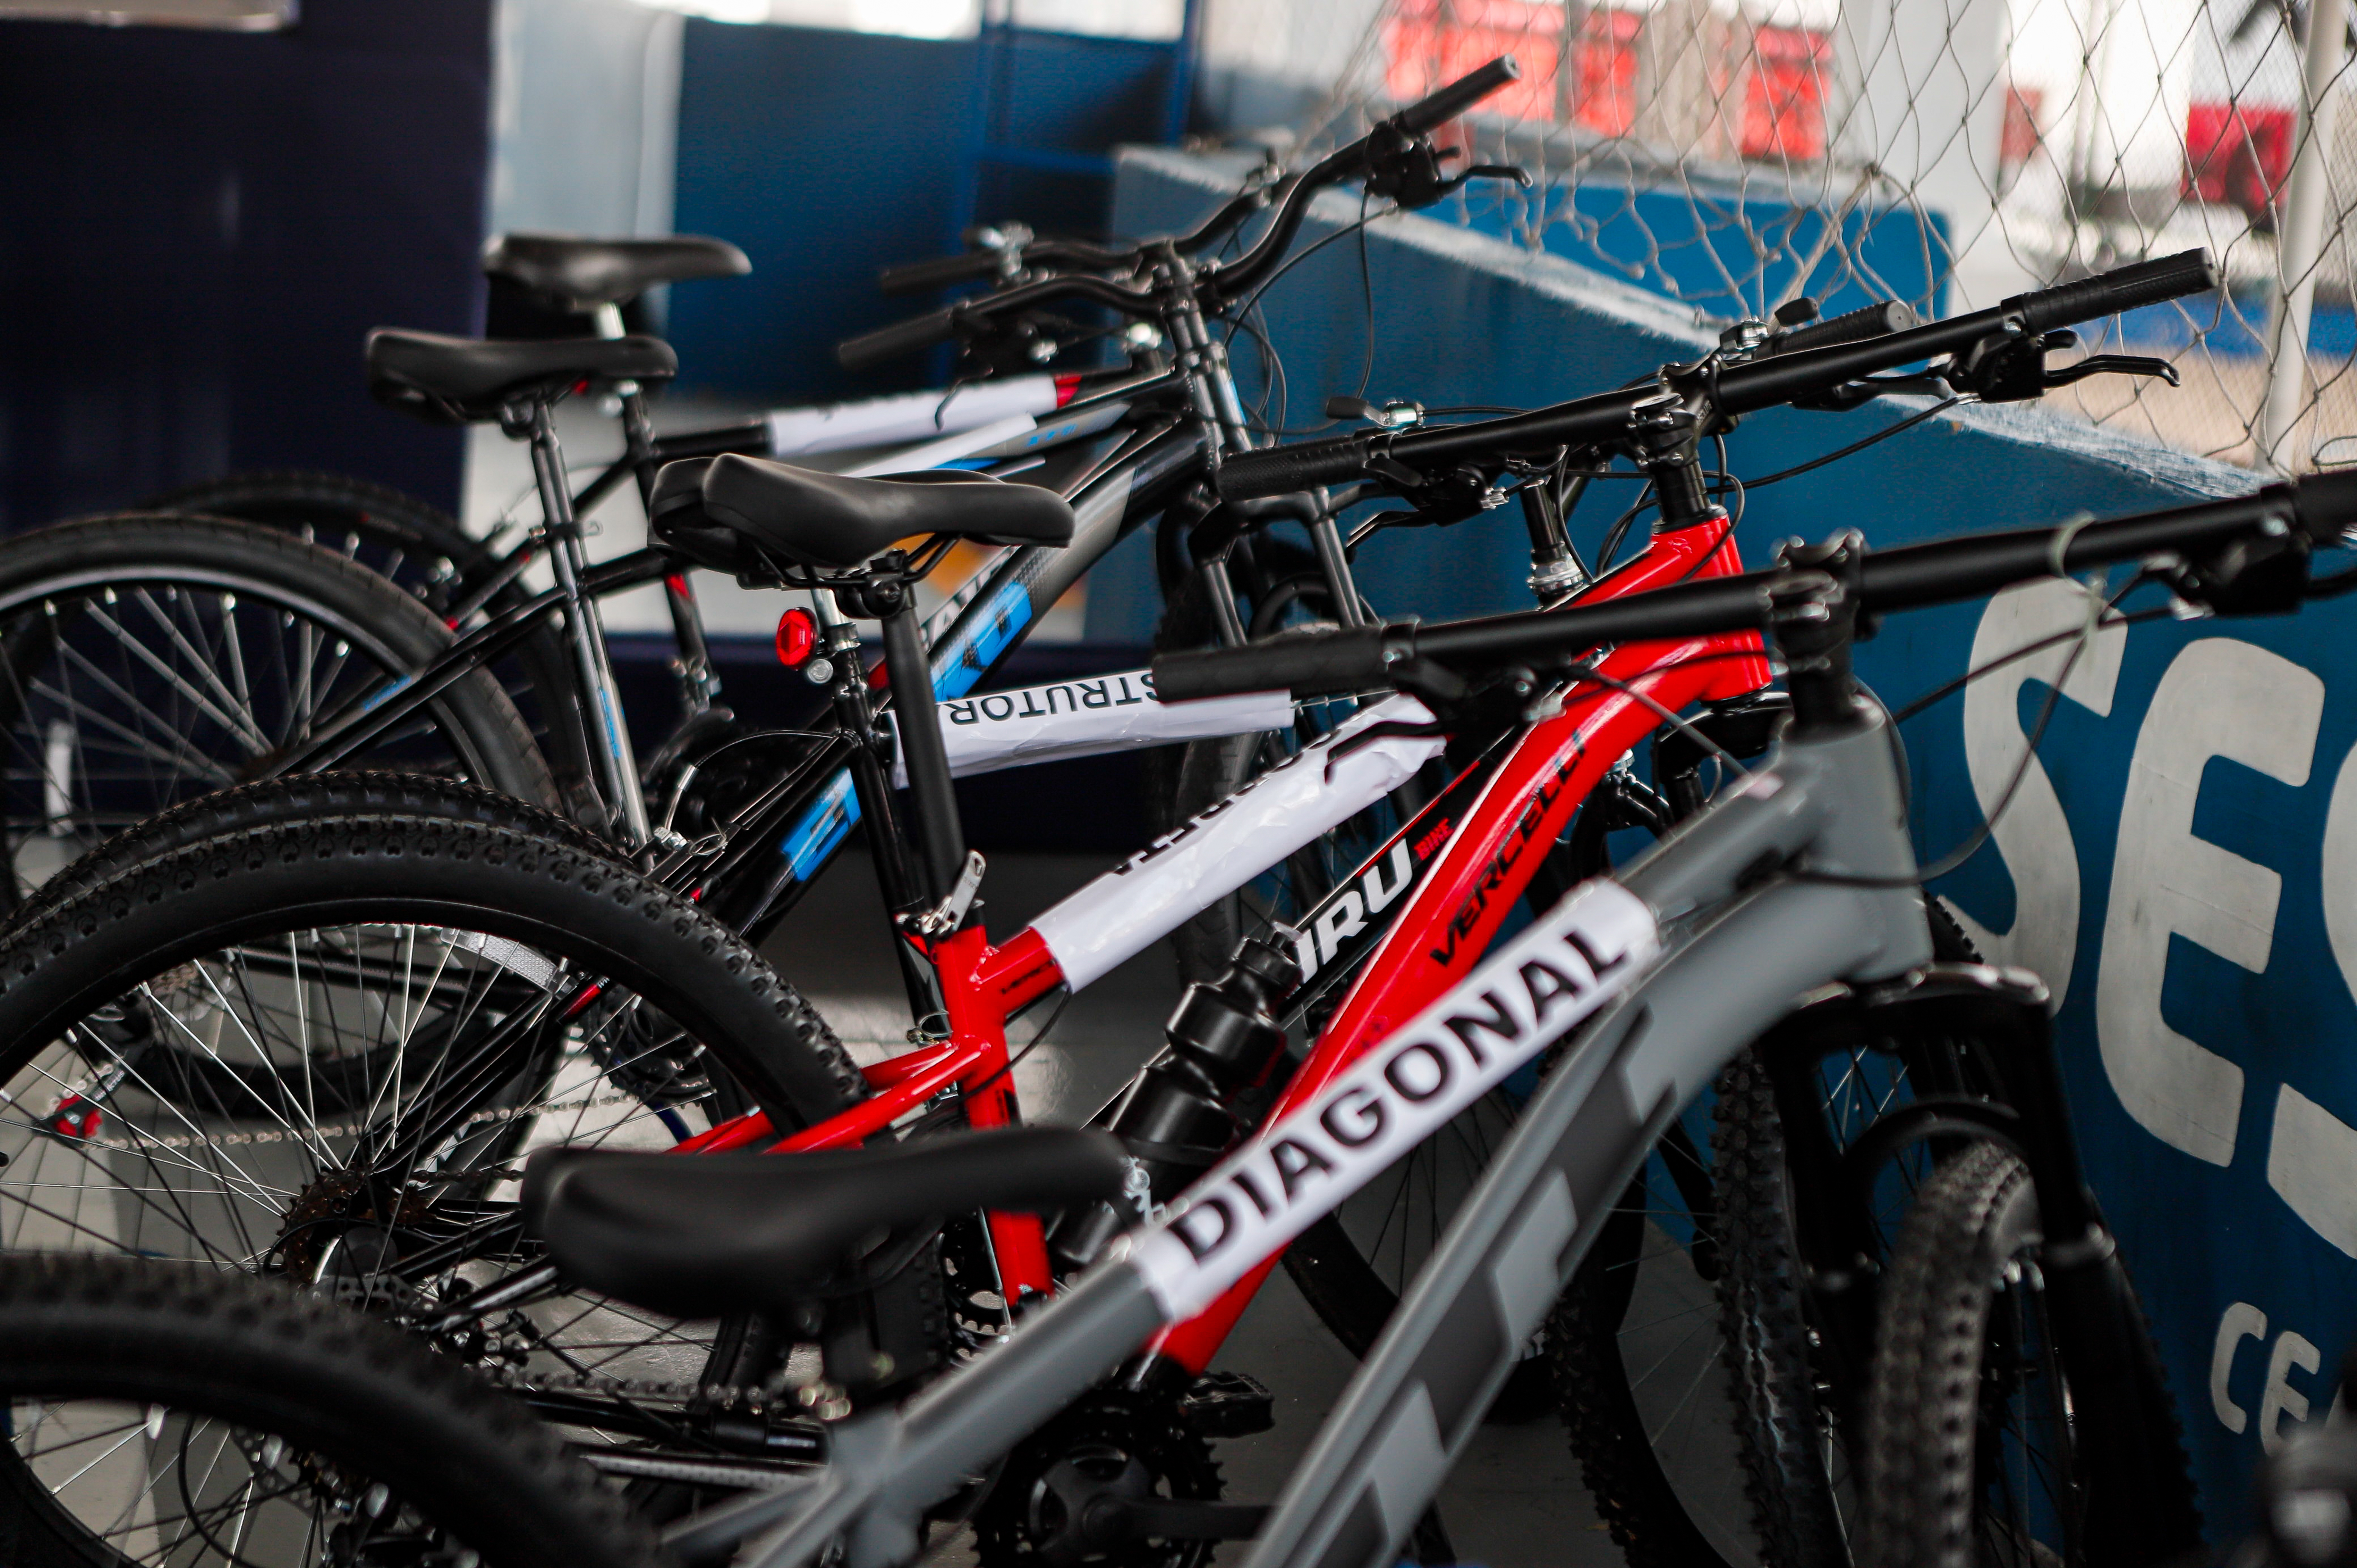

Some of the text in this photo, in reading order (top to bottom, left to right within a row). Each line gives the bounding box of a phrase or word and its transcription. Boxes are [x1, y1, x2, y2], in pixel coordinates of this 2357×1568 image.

[1415, 817, 1454, 861] BIKE
[1430, 729, 1587, 966] VERCELLI
[1167, 930, 1629, 1263] DIAGONAL
[2209, 1301, 2344, 1459] CE
